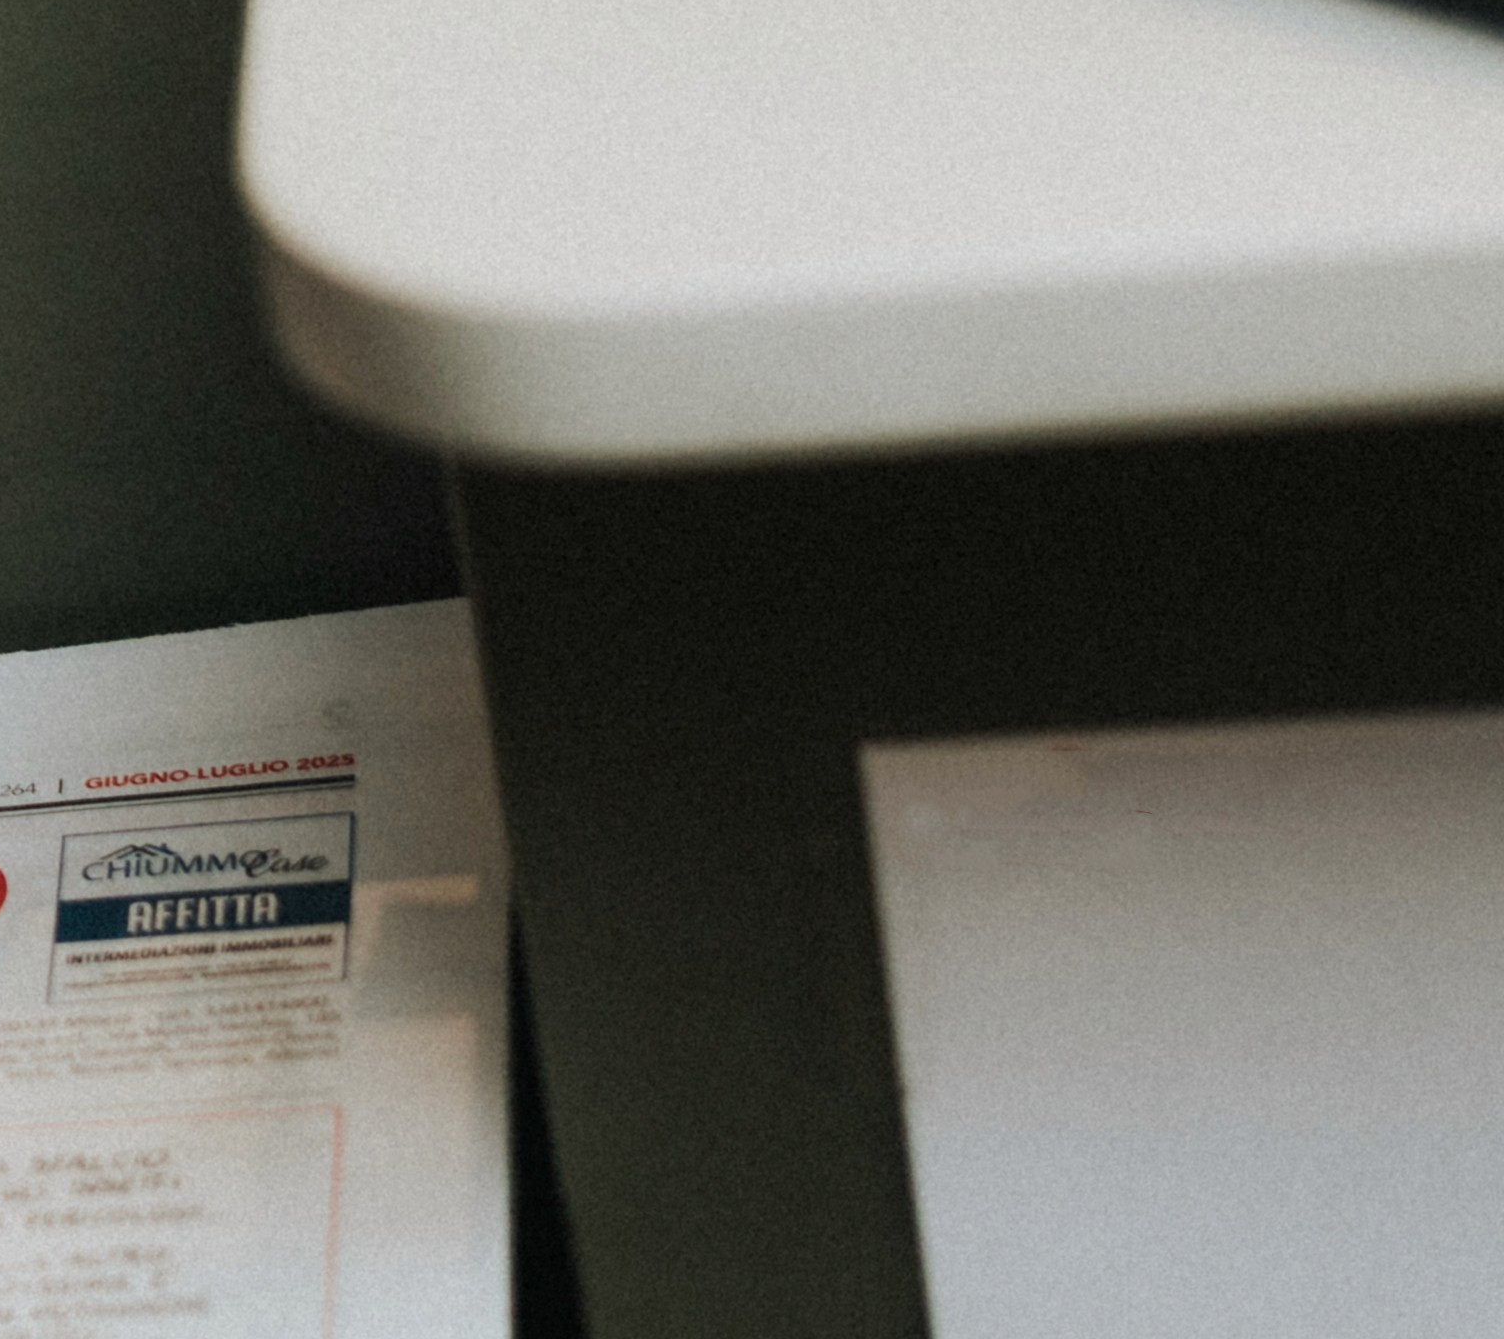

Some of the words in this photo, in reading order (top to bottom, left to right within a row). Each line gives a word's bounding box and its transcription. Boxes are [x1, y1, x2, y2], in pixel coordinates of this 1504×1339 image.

[84, 759, 290, 791] GIUGNO-LUGLIO
[296, 752, 358, 772] 2025
[126, 891, 280, 935] AFFITTA
